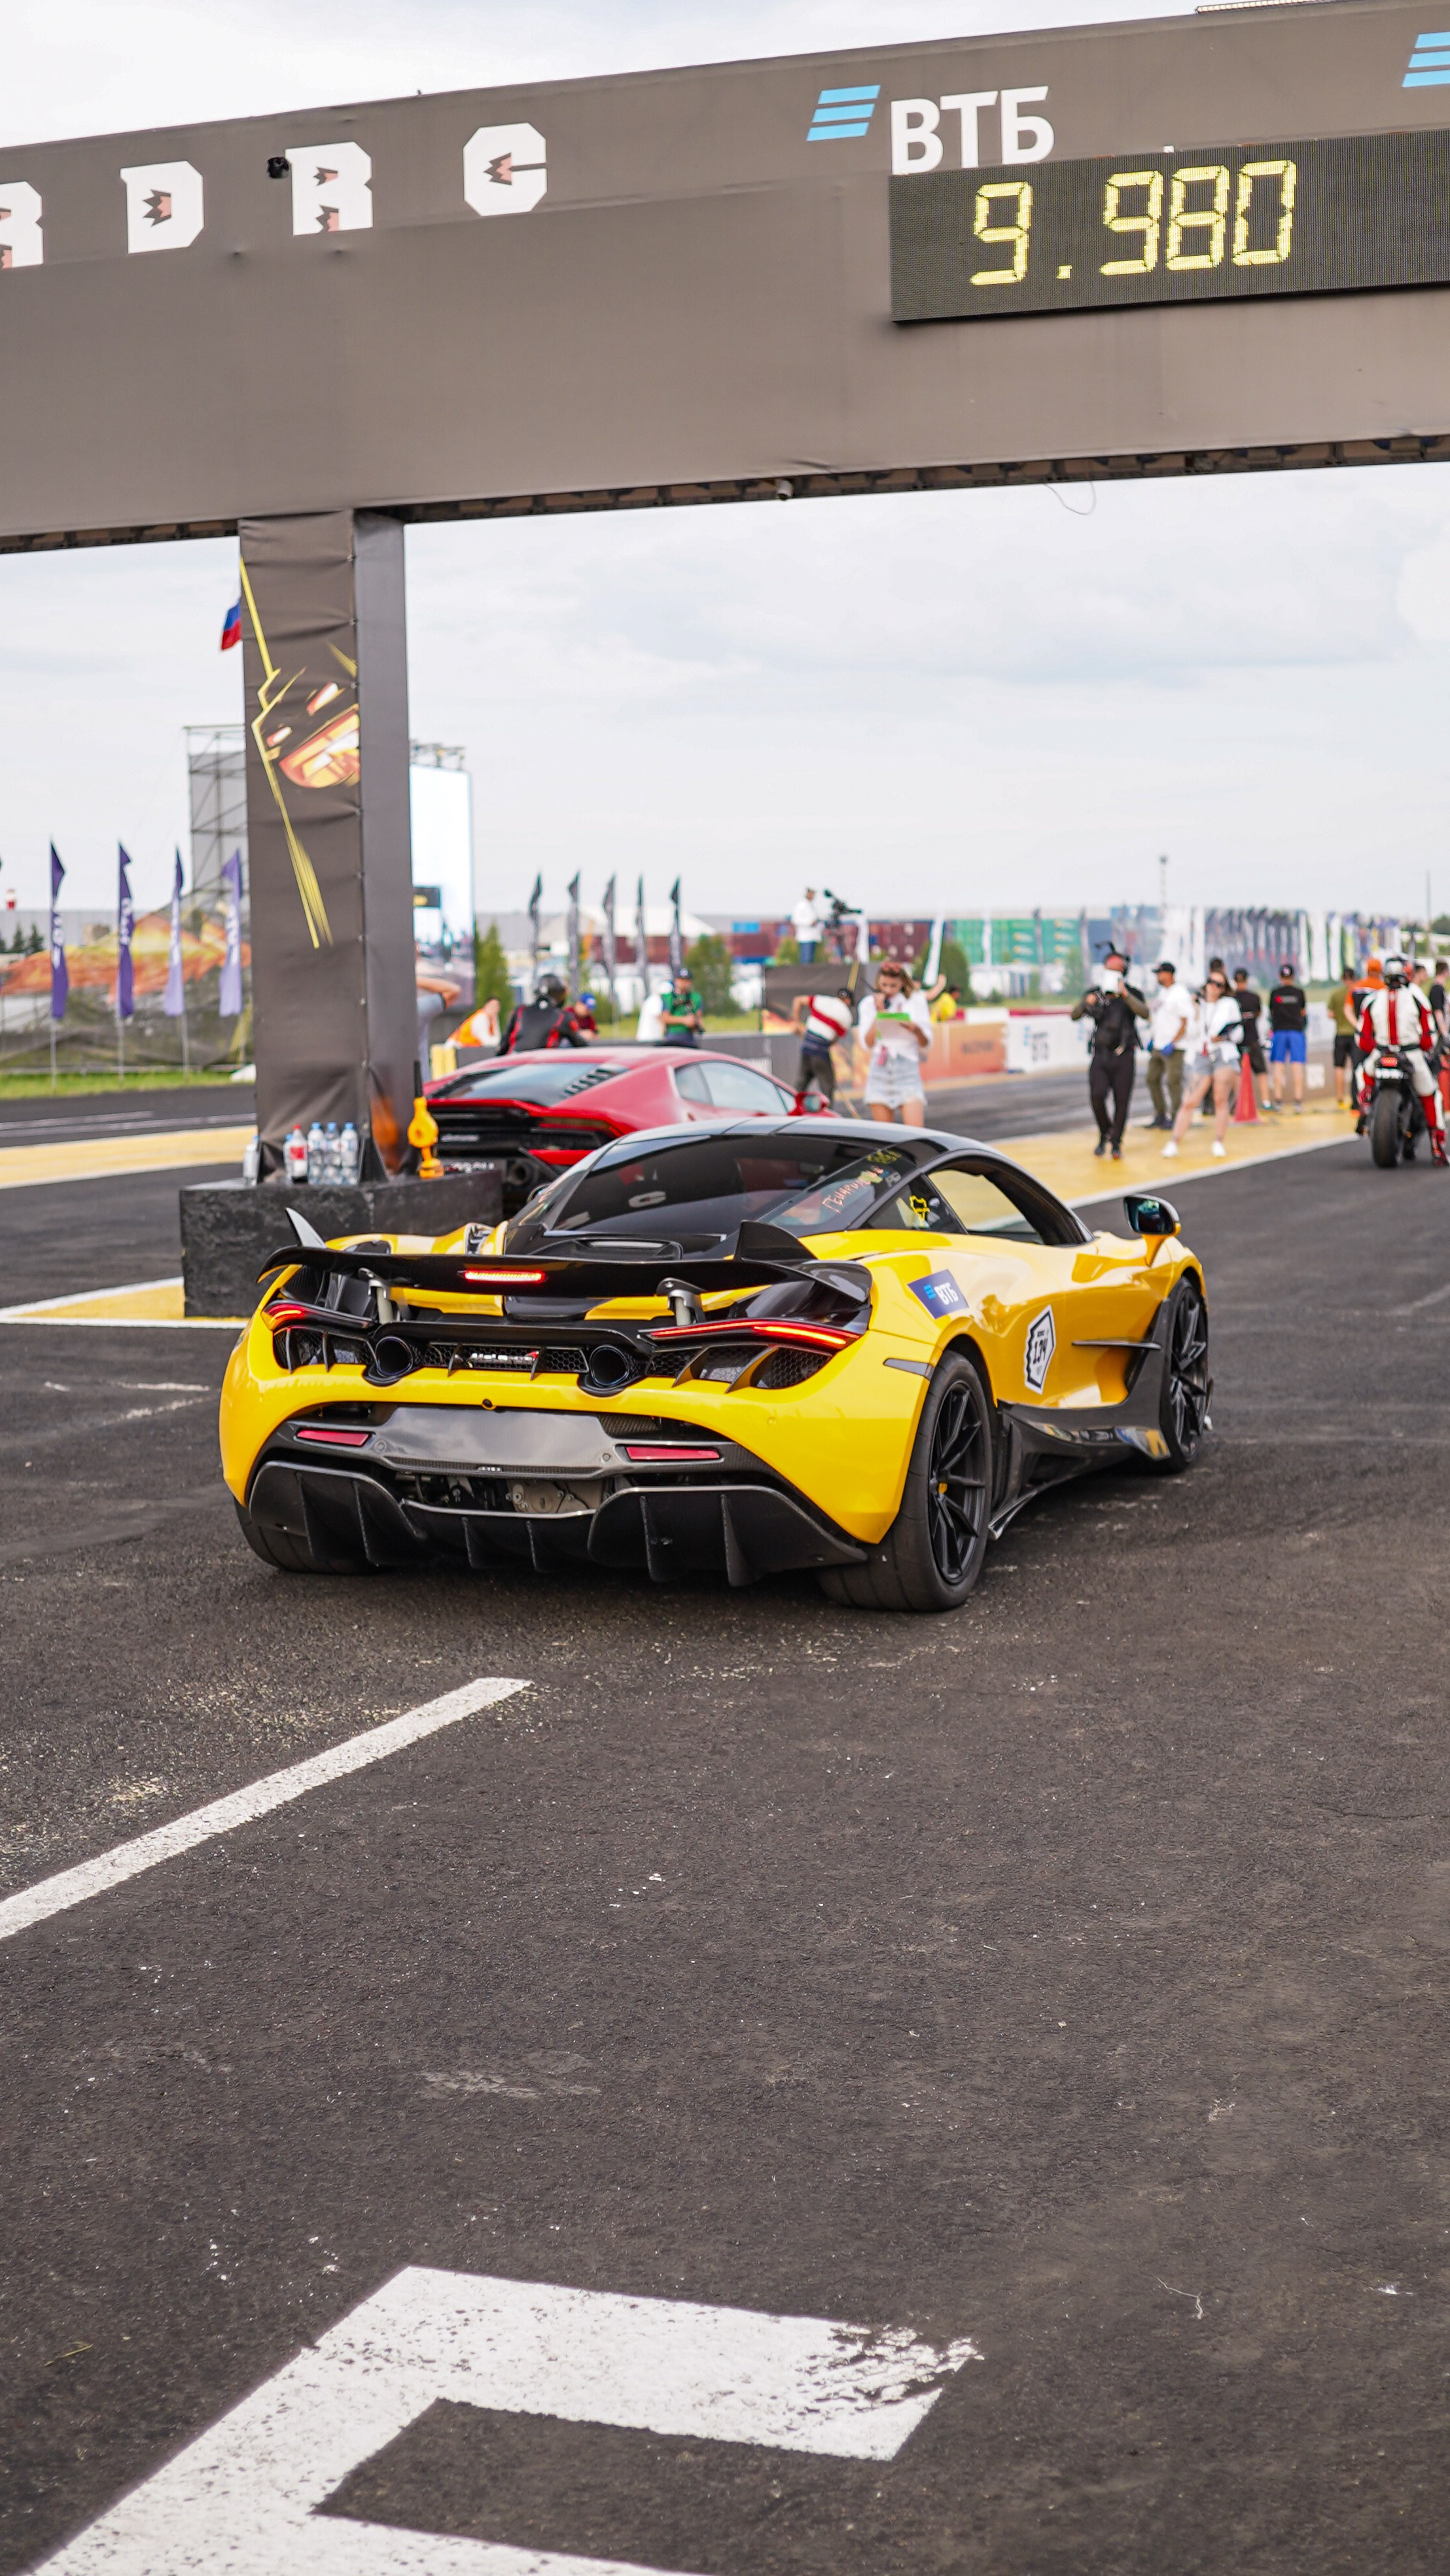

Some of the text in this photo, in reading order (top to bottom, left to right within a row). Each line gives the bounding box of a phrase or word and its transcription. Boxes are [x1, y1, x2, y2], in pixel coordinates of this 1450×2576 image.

[891, 86, 1055, 175] ВТБ
[970, 160, 1298, 286] 9.980
[934, 1283, 959, 1305] ВТБ
